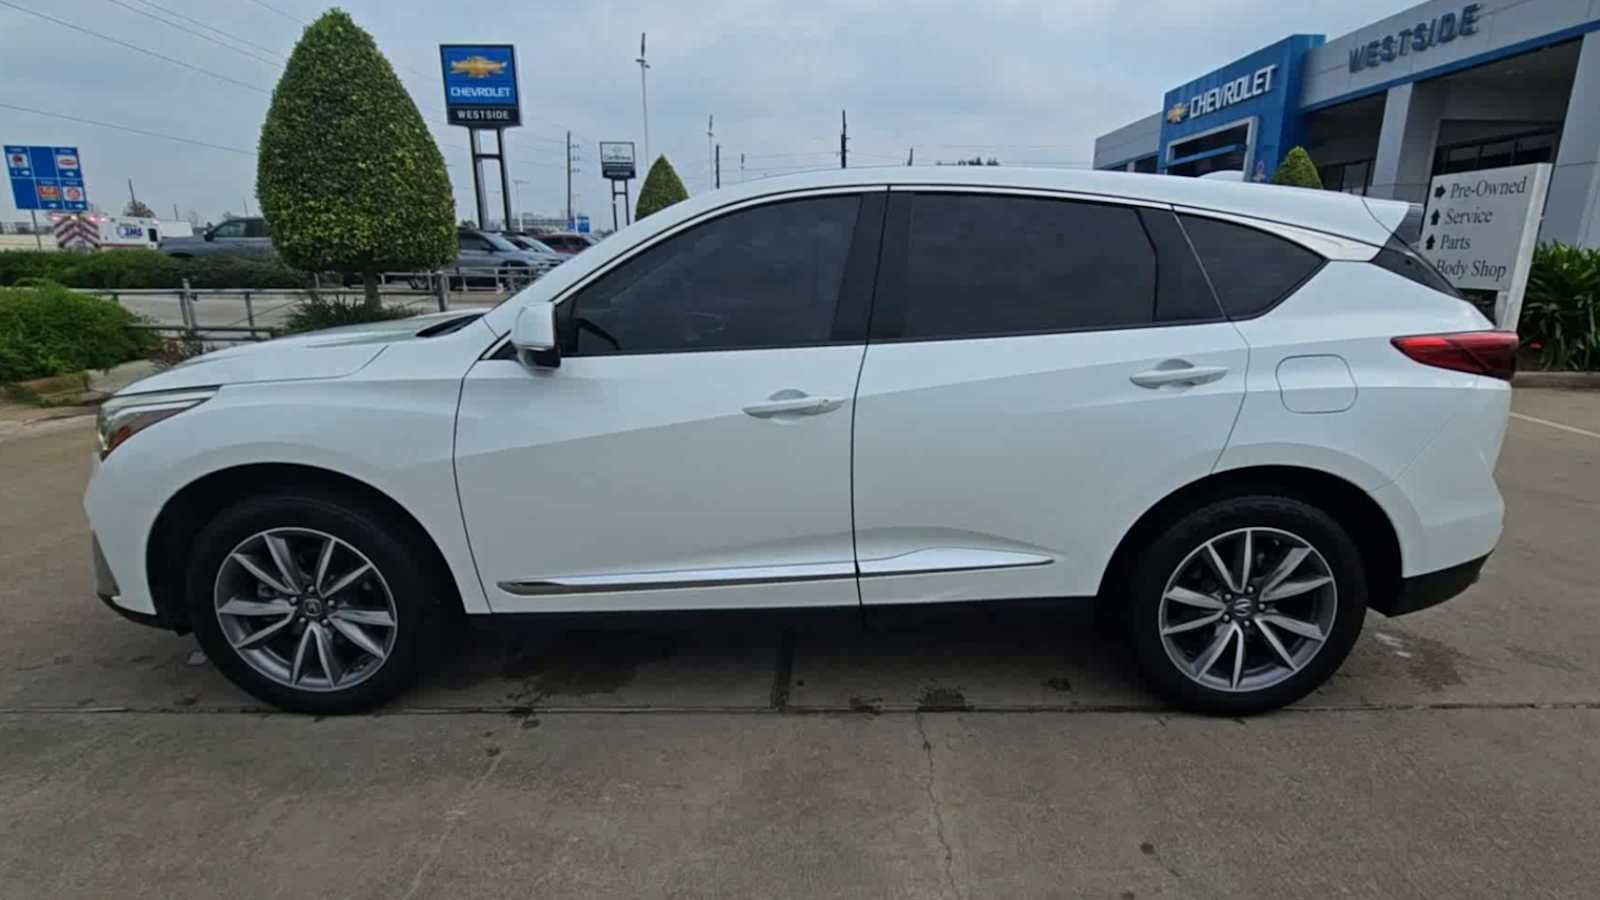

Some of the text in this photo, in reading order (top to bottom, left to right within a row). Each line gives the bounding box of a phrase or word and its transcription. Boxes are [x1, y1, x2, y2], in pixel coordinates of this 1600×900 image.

[1349, 3, 1480, 73] WESTSIDE
[450, 87, 511, 97] CHEVROLET
[1189, 64, 1278, 119] CHEVROLET
[456, 110, 510, 120] WESTSIDE
[1450, 176, 1527, 199] Pre-Owned
[1445, 207, 1493, 225] Service
[1440, 234, 1471, 250] Parts
[1471, 260, 1507, 282] Shop
